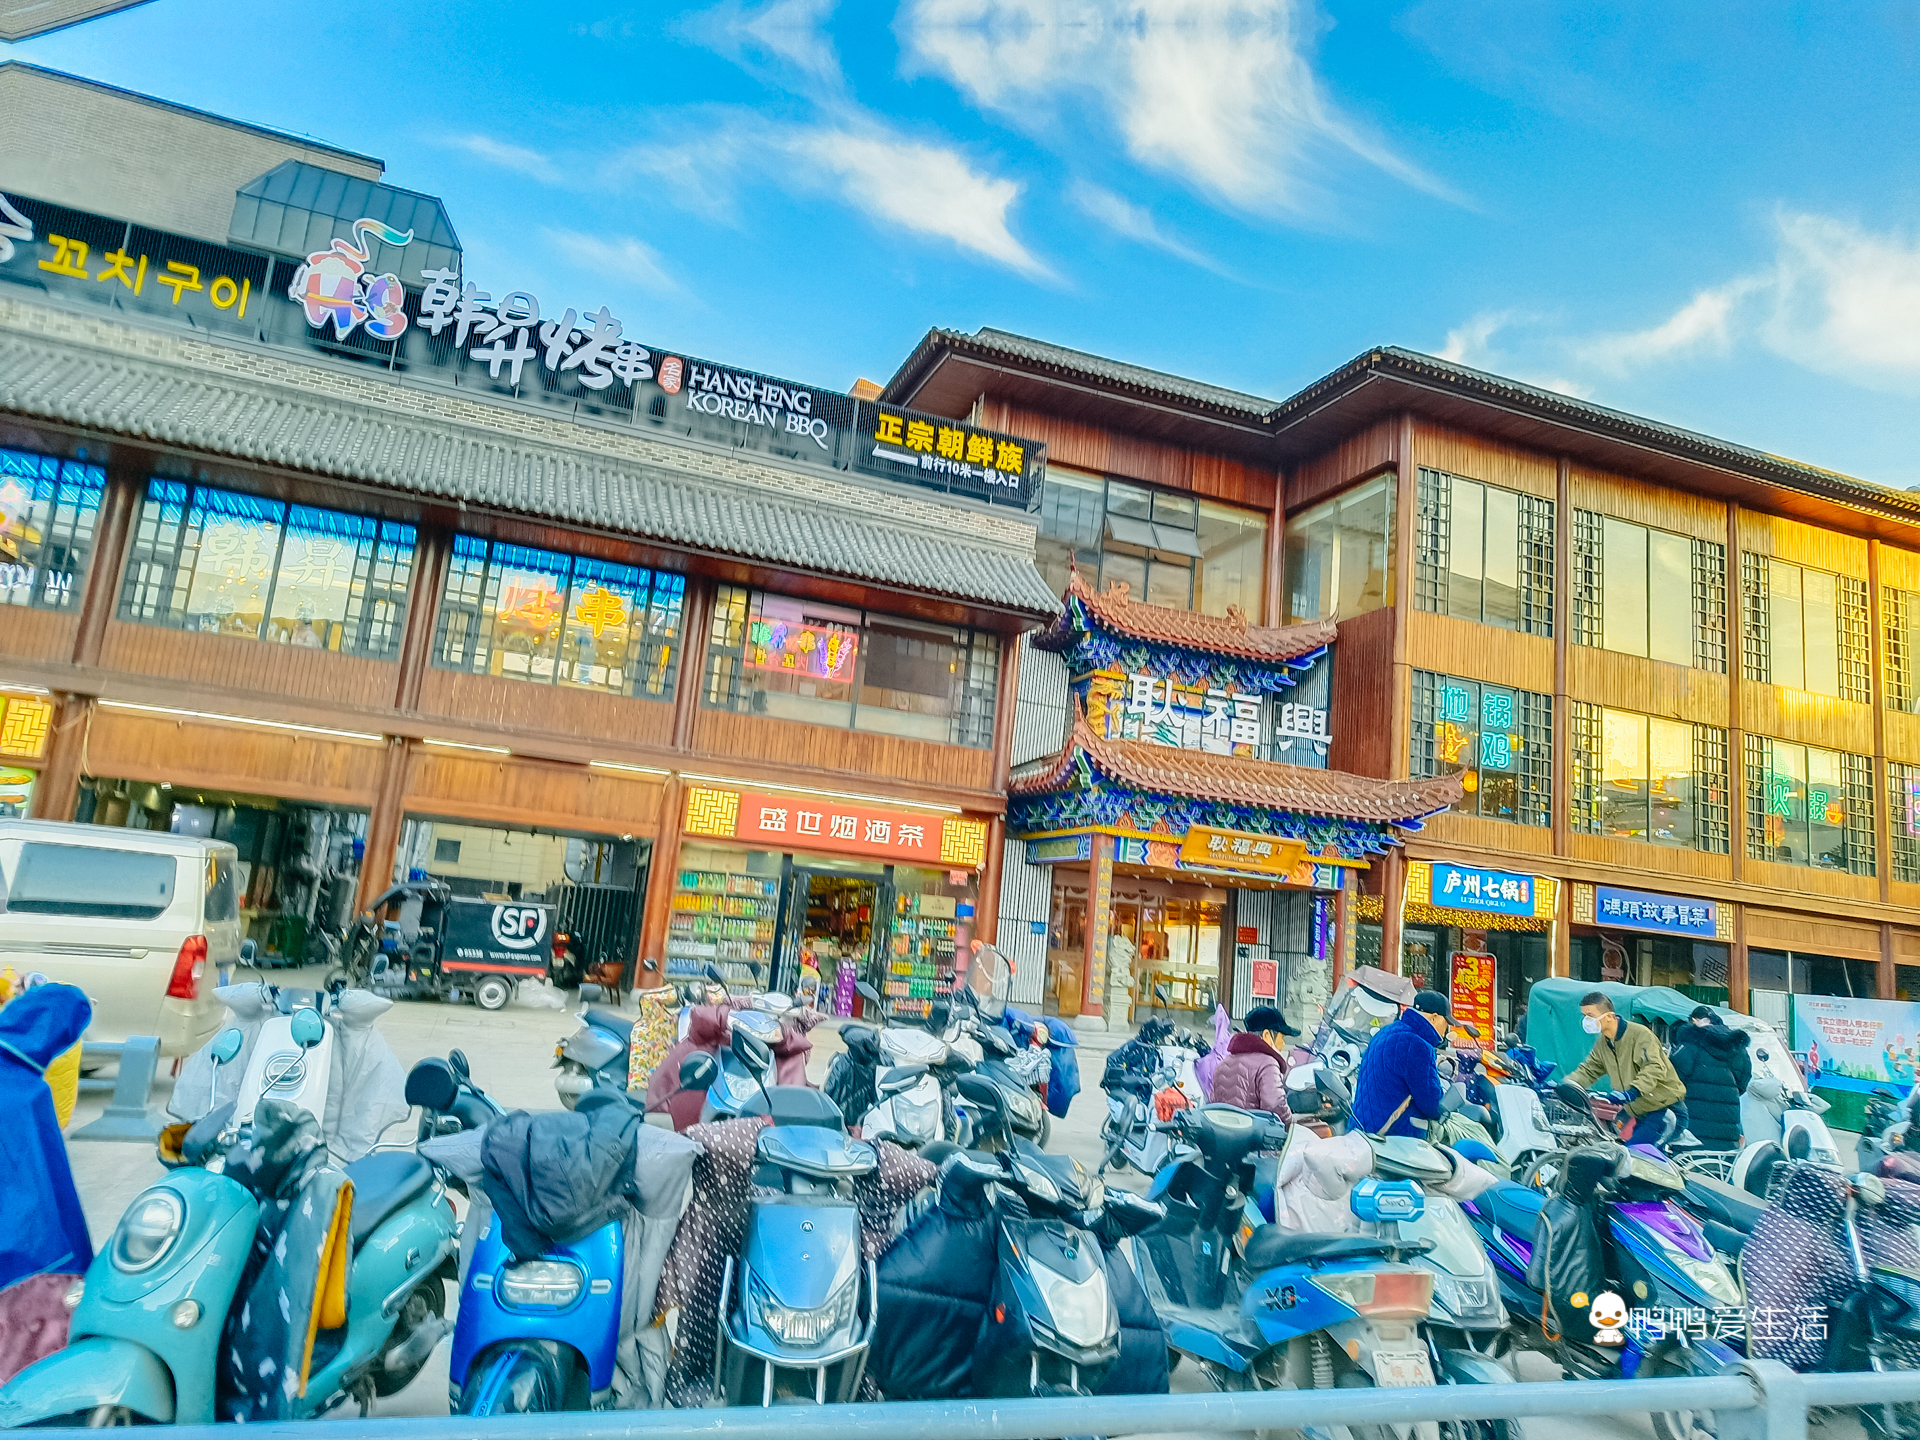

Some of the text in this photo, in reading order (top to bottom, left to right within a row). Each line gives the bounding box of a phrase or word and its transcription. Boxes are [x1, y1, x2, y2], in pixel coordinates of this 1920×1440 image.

[38, 233, 251, 320] 꼬치구이
[416, 267, 653, 390] 韩昇烤串
[686, 387, 829, 451] KOREAN BBQ
[688, 364, 812, 414] HANSHENG
[874, 412, 1024, 475] 正宗朝鲜族
[920, 454, 1020, 490] 前行10米一楼入口
[1127, 673, 1333, 756] 耿福興
[759, 806, 925, 848] 盛世烟酒茶
[1443, 869, 1520, 903] 庐州七锅
